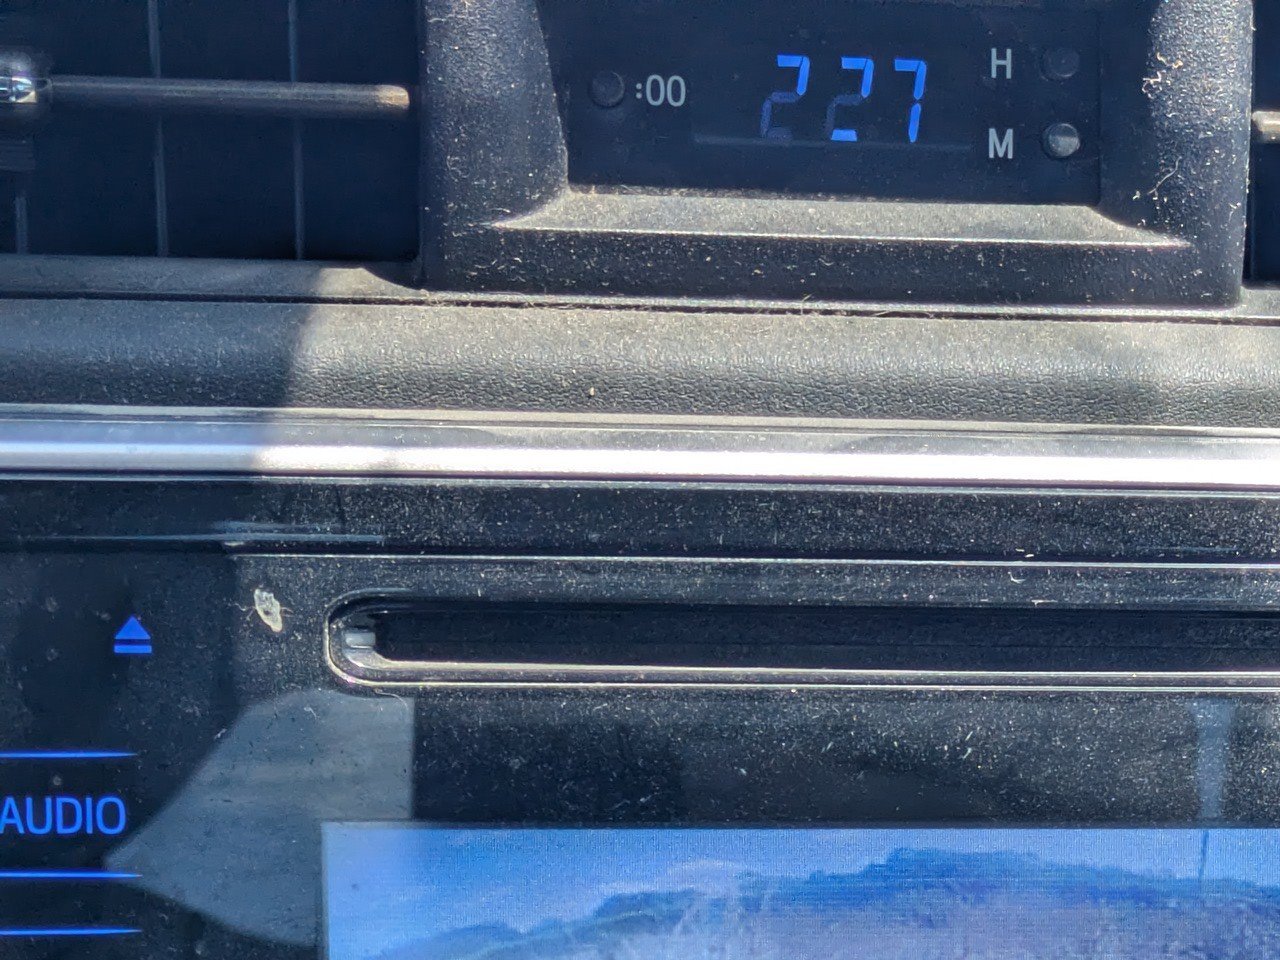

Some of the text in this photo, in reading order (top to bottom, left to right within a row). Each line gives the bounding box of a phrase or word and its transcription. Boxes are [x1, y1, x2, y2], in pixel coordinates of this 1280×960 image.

[990, 48, 1012, 79] H
[988, 128, 1014, 159] M
[0, 796, 127, 836] AUDIO
